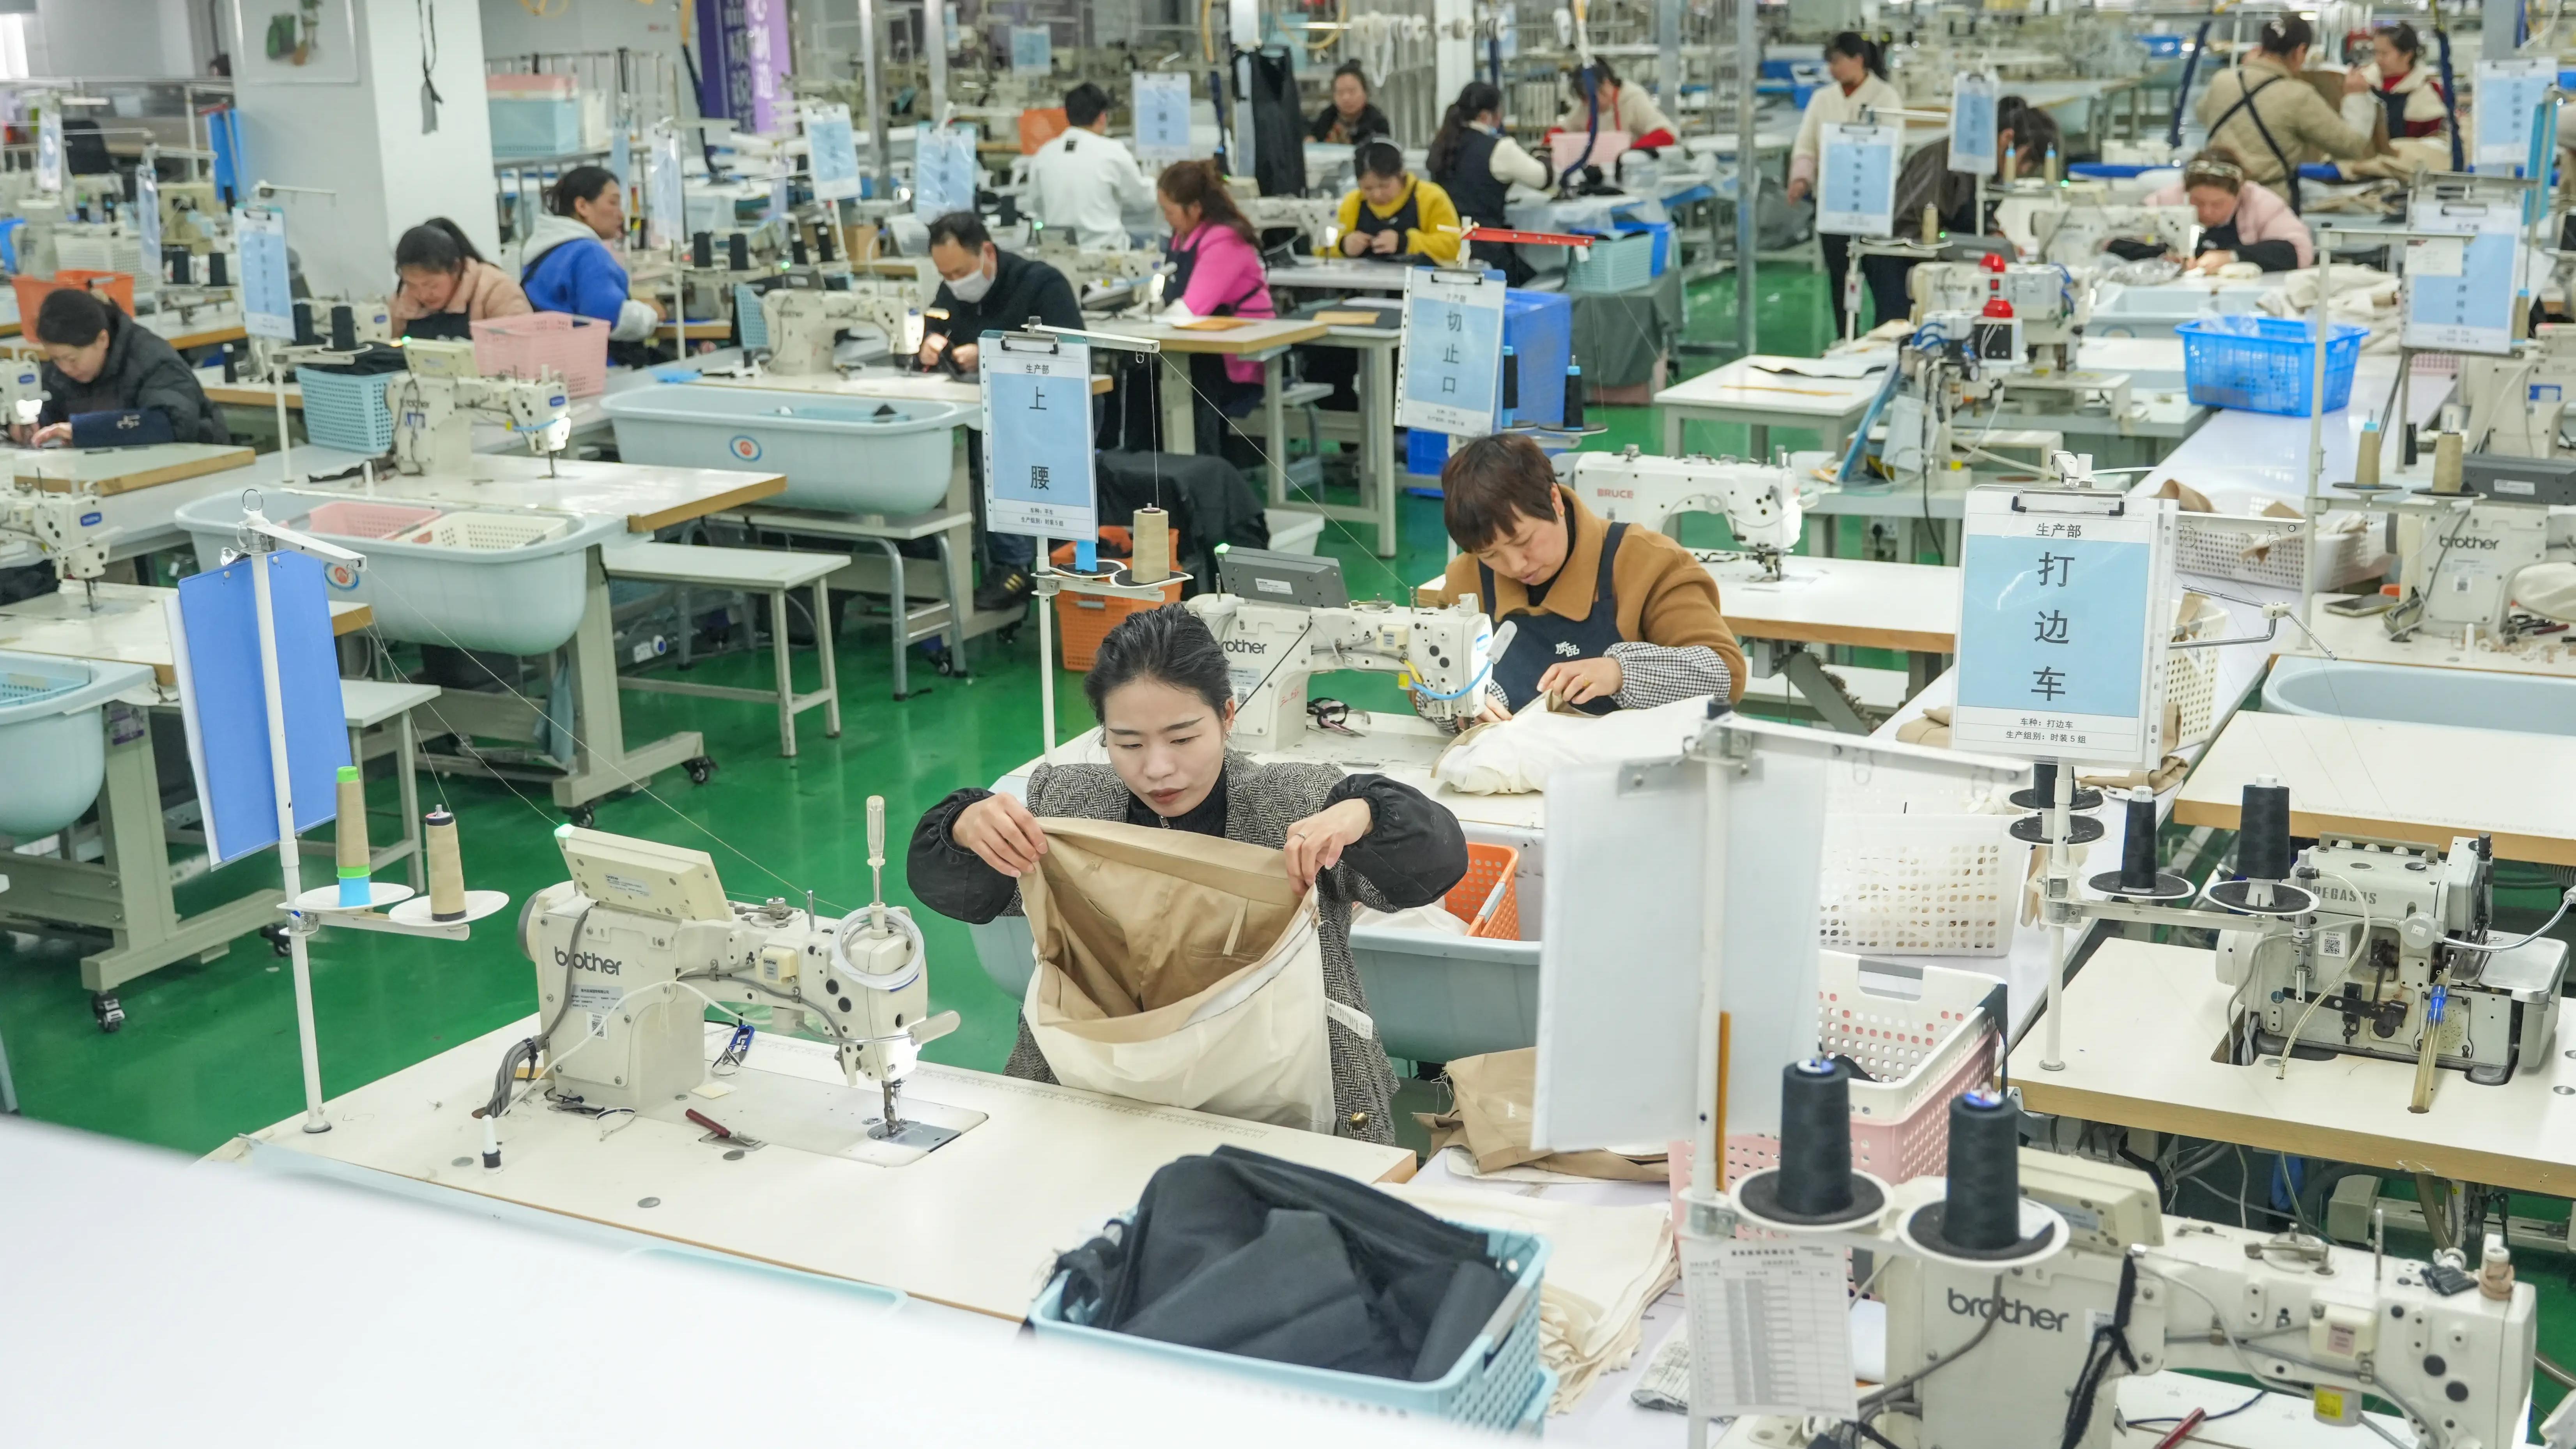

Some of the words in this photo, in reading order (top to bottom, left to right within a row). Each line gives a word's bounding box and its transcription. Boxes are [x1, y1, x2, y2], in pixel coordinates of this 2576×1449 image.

[1442, 310, 1462, 394] 切止口
[1026, 364, 1050, 375] 生产部
[1029, 386, 1050, 490] 上腰
[1597, 488, 1633, 499] BRUCE
[2036, 523, 2081, 538] 生产部
[2439, 535, 2500, 550] brother
[2031, 552, 2075, 701] 打边车
[1222, 639, 1267, 654] rother
[2020, 717, 2073, 729] 车种：打边车
[555, 946, 622, 975] bother
[1948, 1288, 2069, 1332] brother
